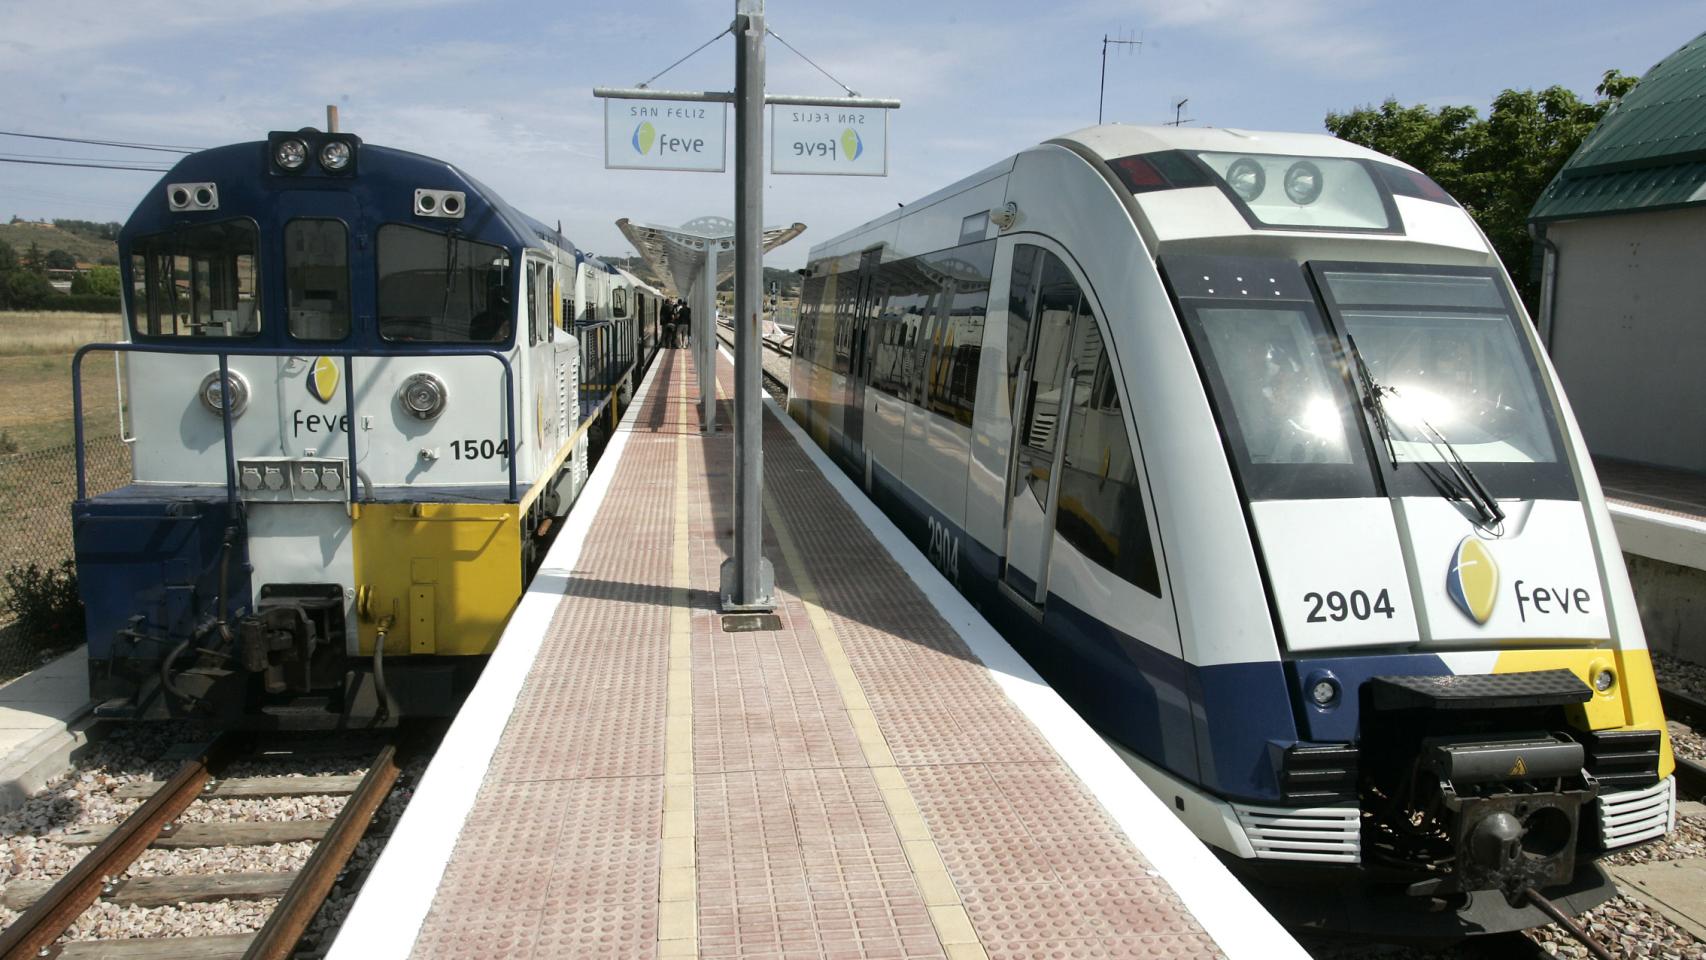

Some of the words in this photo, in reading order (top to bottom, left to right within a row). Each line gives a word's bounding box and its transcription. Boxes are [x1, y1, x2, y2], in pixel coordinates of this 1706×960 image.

[630, 106, 658, 118] SAN
[667, 107, 705, 119] FELIZ
[659, 133, 705, 156] feve
[449, 438, 509, 460] 1504
[928, 515, 960, 585] 2904
[1303, 588, 1396, 624] 2904
[1515, 580, 1591, 623] feve
